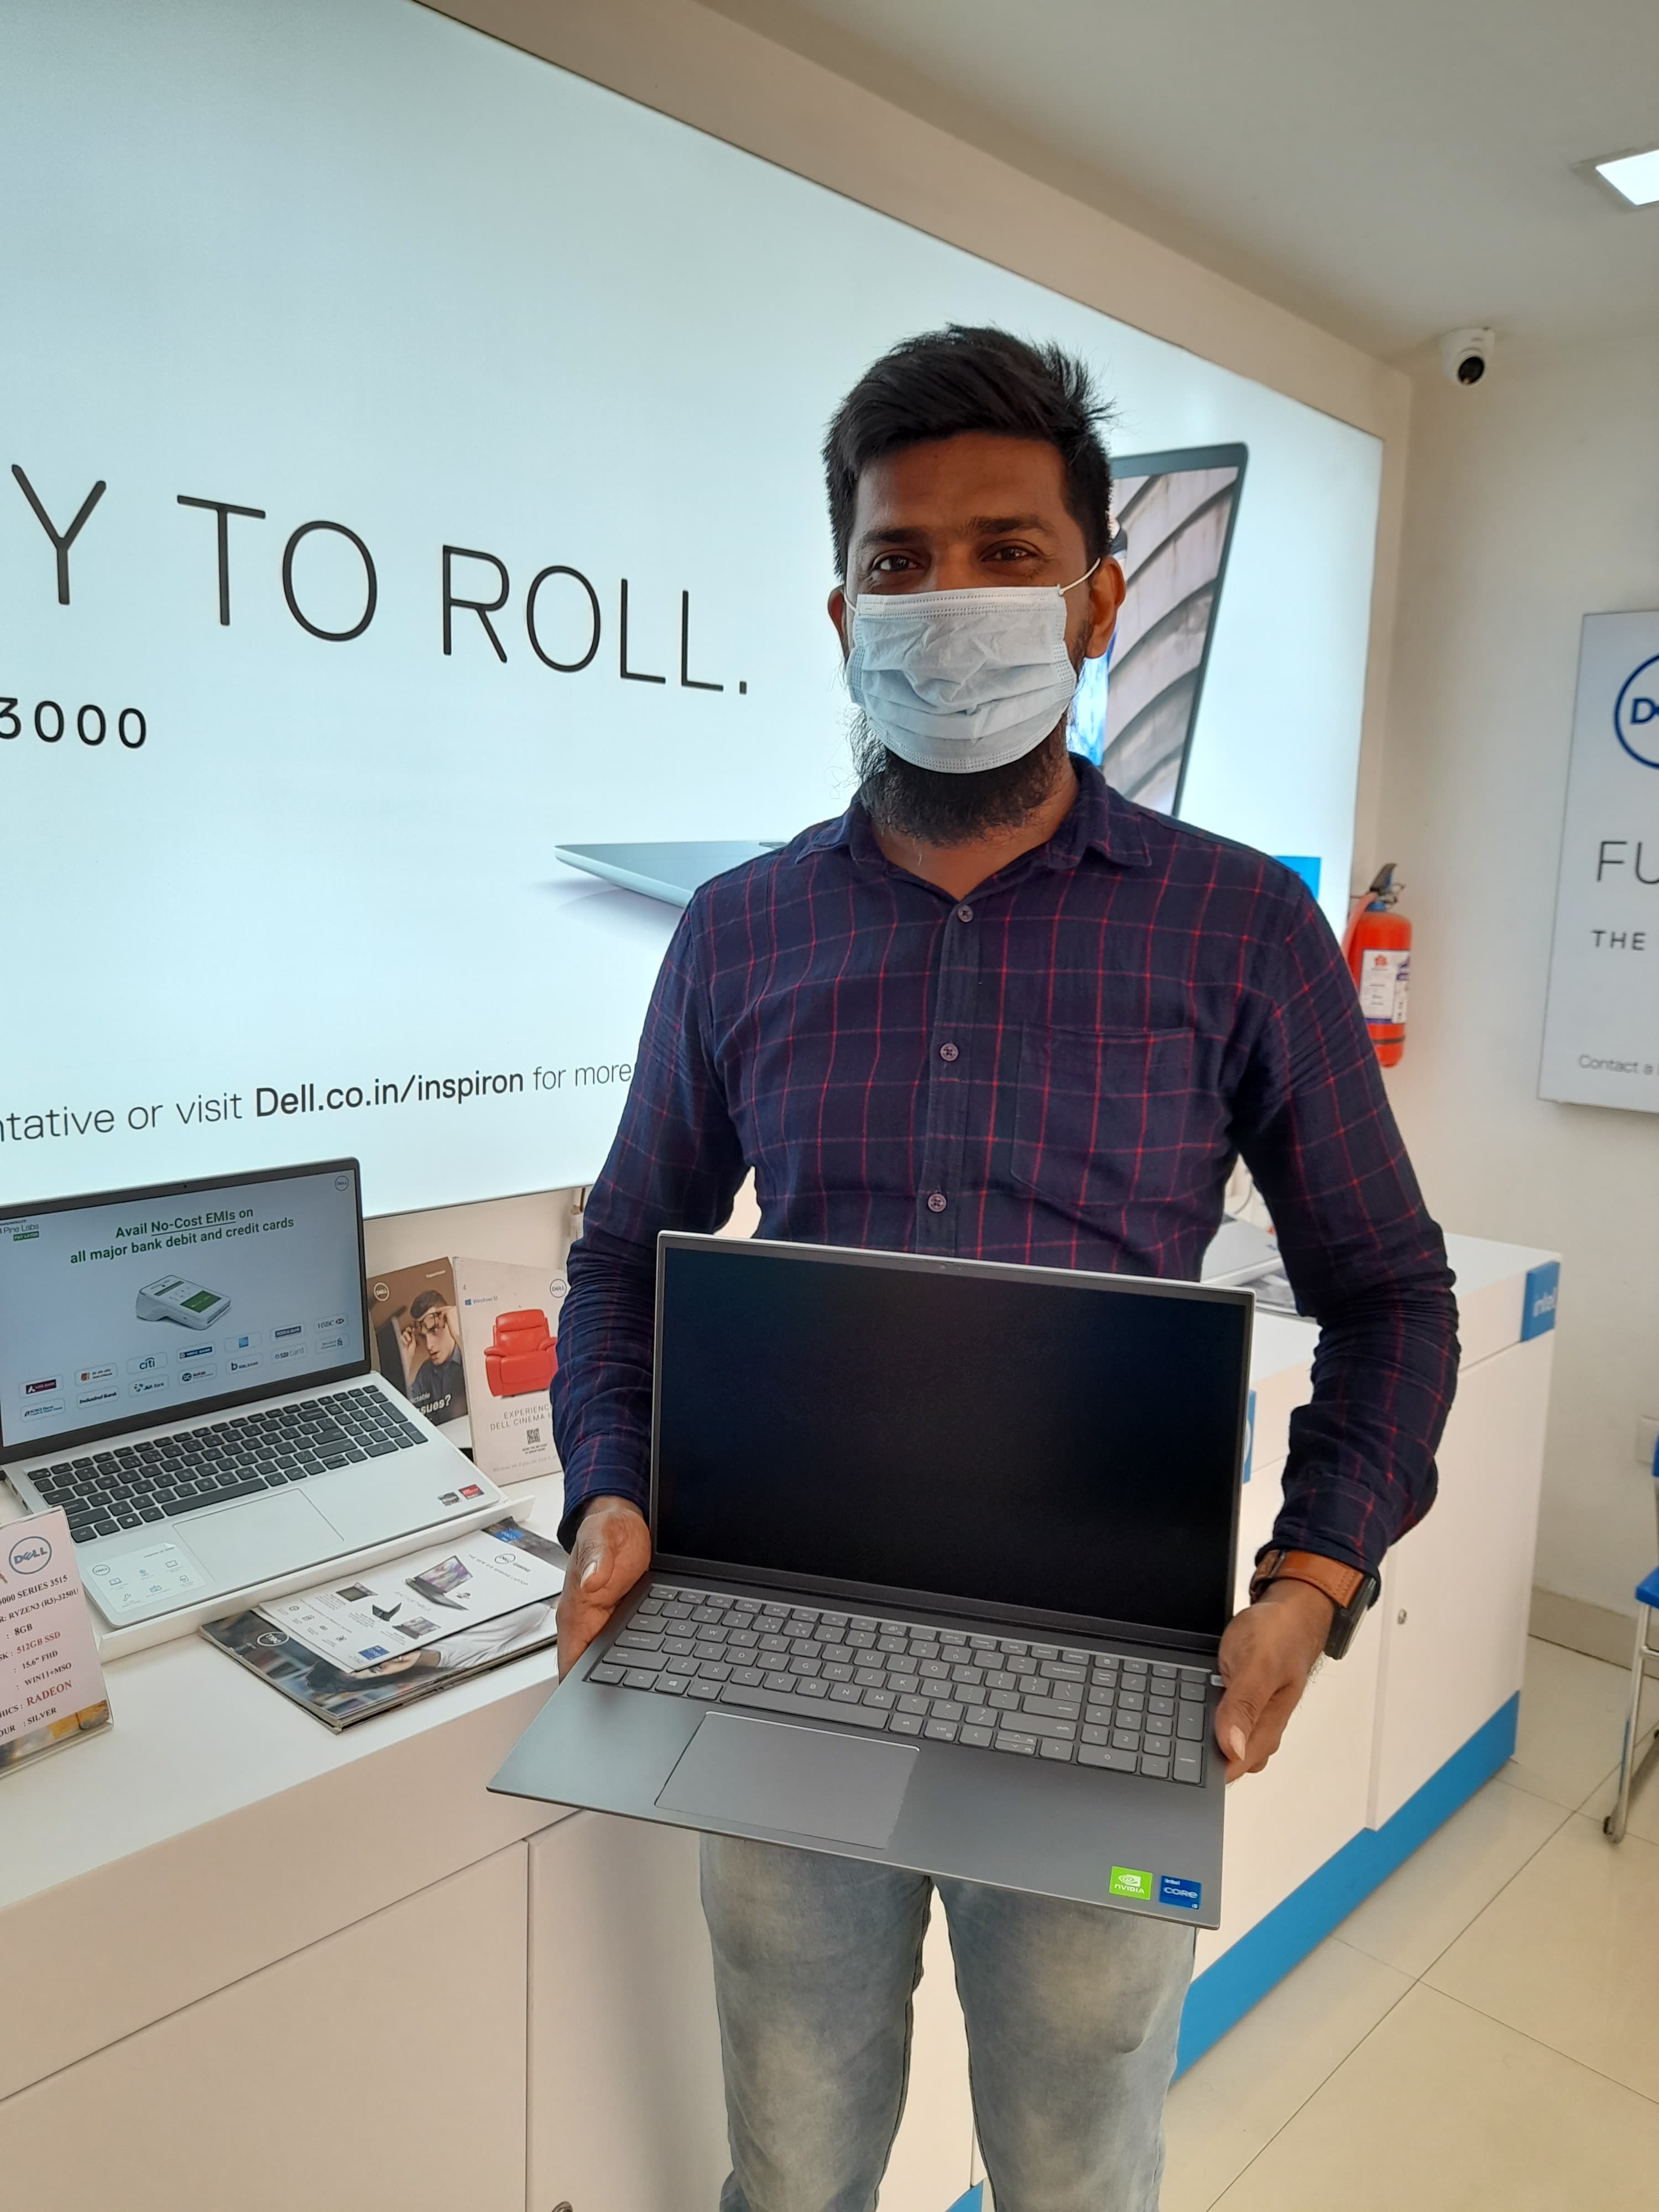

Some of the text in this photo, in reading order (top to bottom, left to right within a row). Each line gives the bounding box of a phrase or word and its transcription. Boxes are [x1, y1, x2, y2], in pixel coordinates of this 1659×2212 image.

[177, 495, 377, 641] TO
[443, 545, 747, 695] ROLL.
[0, 697, 147, 749] 3000
[1592, 929, 1646, 951] THE
[1579, 1053, 1638, 1073] Contact
[128, 1104, 164, 1130] or
[176, 1092, 243, 1124] visit
[255, 1071, 524, 1117] Dell.co.in/inspiron
[533, 1066, 567, 1090] for
[575, 1063, 632, 1087] more
[115, 1208, 253, 1238] Avail No-Cost EMIs on
[70, 1217, 294, 1264] all major bank debit and credit cards
[318, 1320, 334, 1328] HSBC
[139, 1358, 155, 1370] citi
[504, 1404, 551, 1420] EXPERIENC
[513, 1413, 545, 1426] CINEMA
[14, 1547, 48, 1564] DELL
[17, 1582, 48, 1599] SERIES
[50, 1574, 67, 1587] 3515
[9, 1603, 40, 1620] RYZEN3
[14, 1623, 33, 1636] 8GB
[17, 1638, 43, 1654] 512GB
[44, 1631, 60, 1642] SSD
[41, 1650, 58, 1661] FHD
[24, 1662, 72, 1686] WIN11+MSO
[27, 1679, 72, 1705] RADEON
[27, 1707, 57, 1725] SILVER
